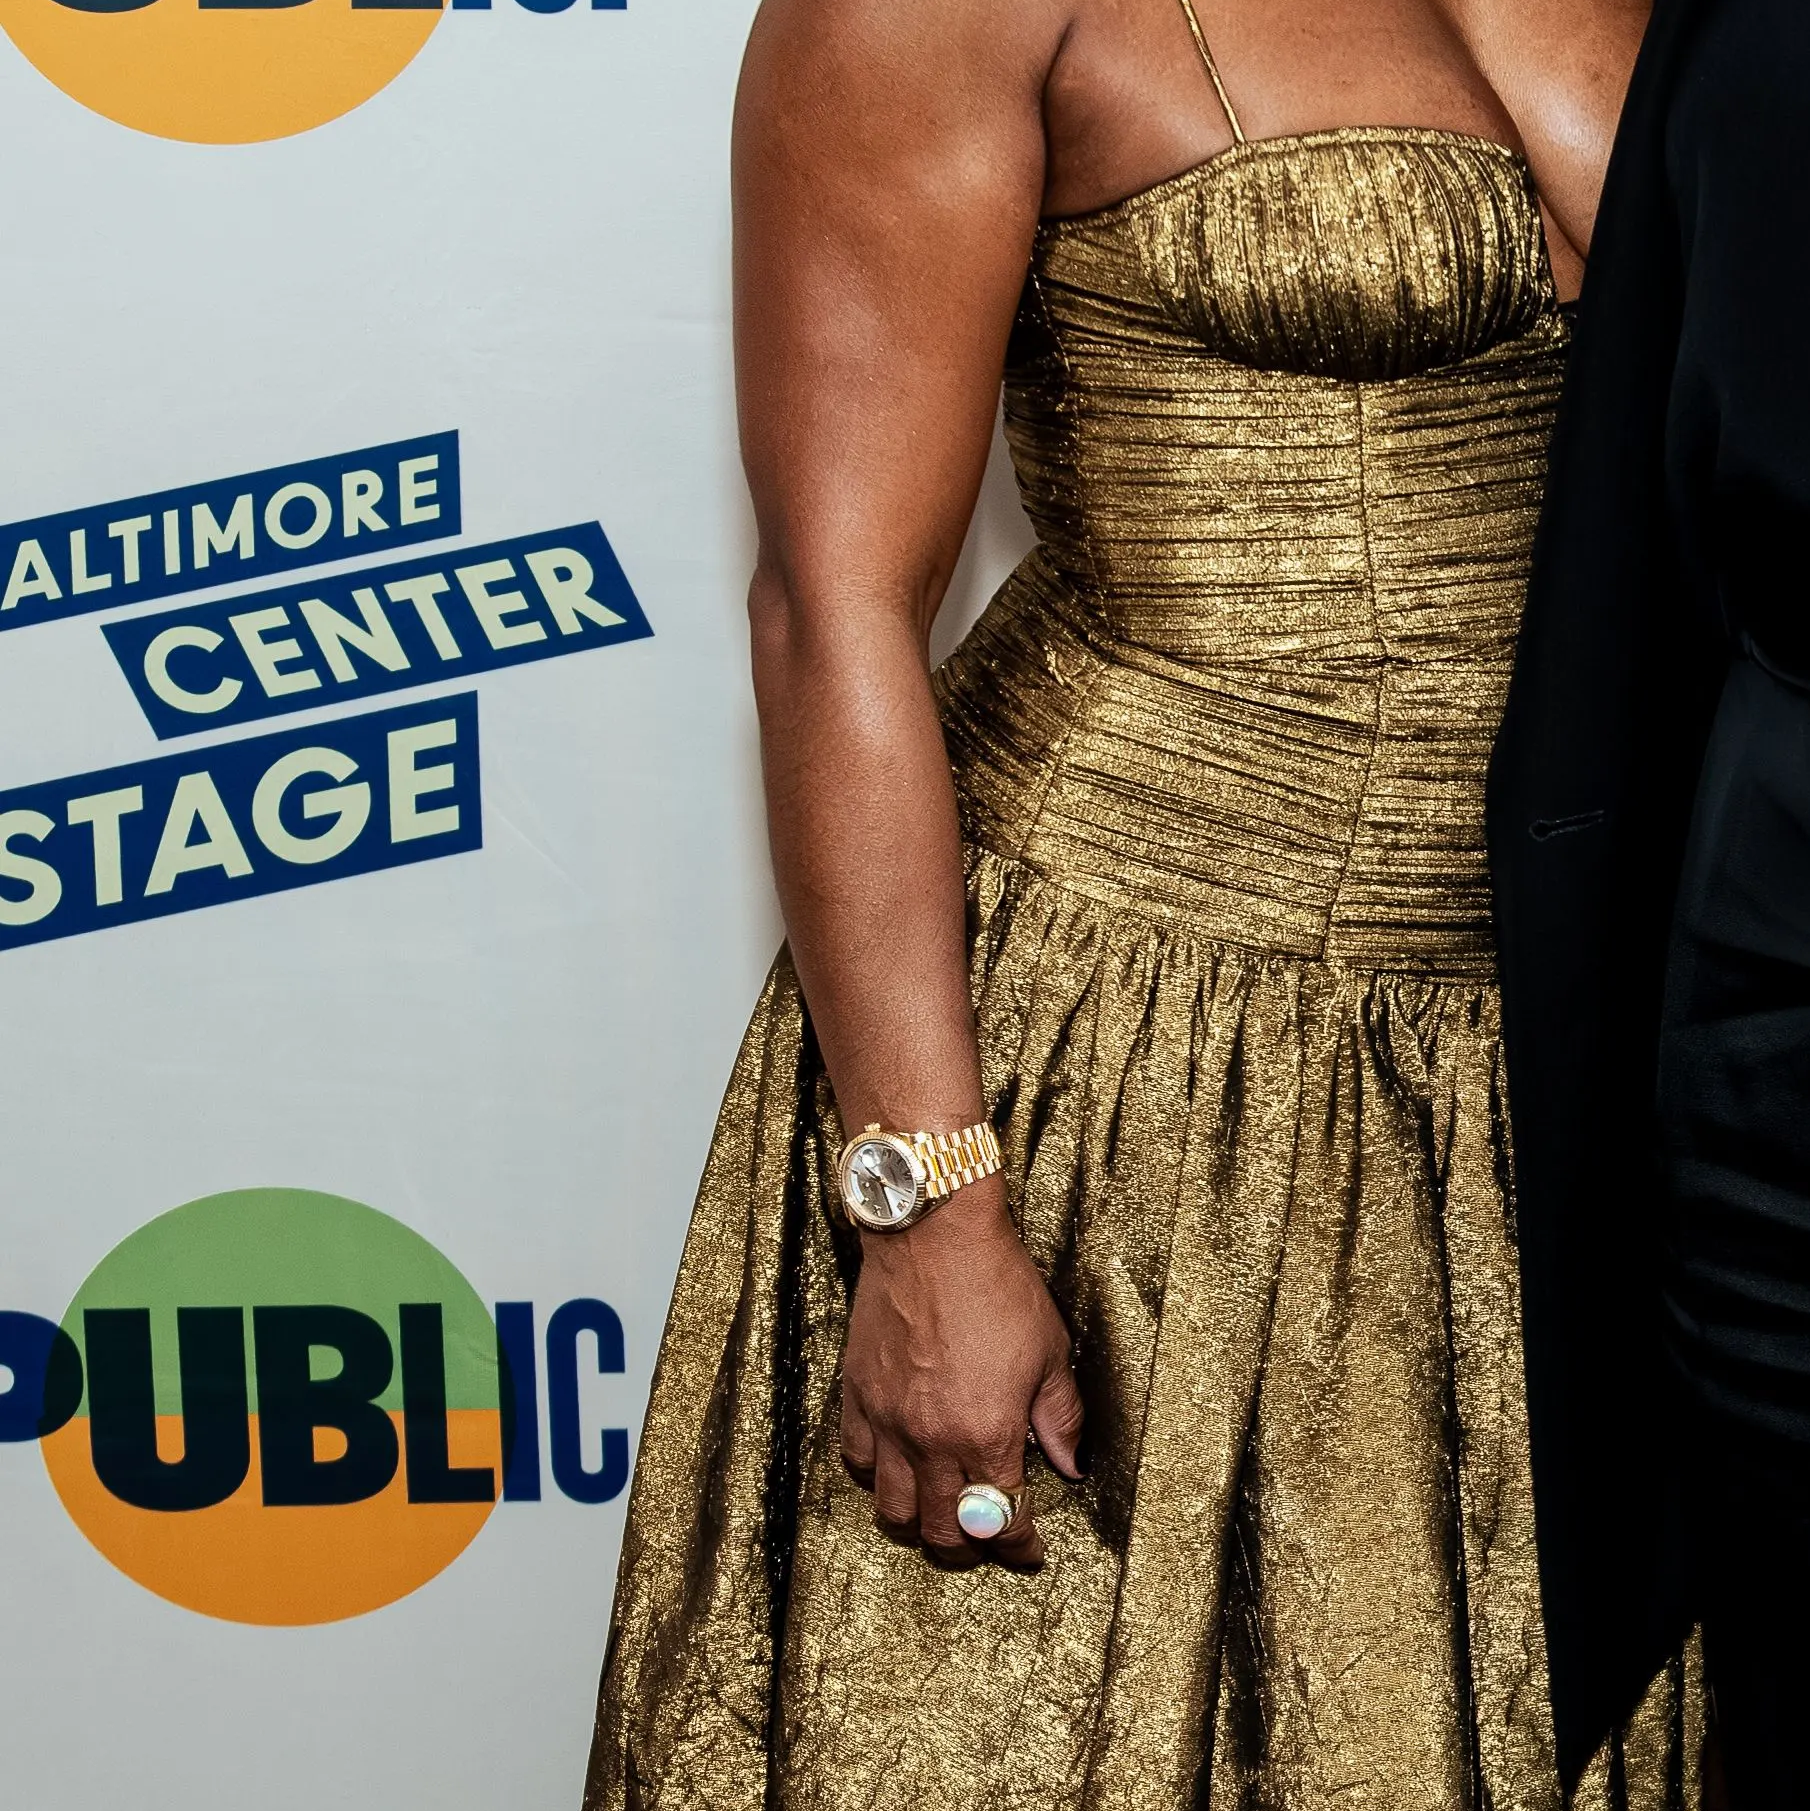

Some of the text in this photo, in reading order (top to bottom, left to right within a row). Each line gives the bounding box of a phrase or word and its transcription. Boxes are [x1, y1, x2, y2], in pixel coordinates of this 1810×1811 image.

[0, 454, 440, 611] ALTIMORE
[144, 546, 627, 713] CENTER
[0, 718, 460, 926] STAGE
